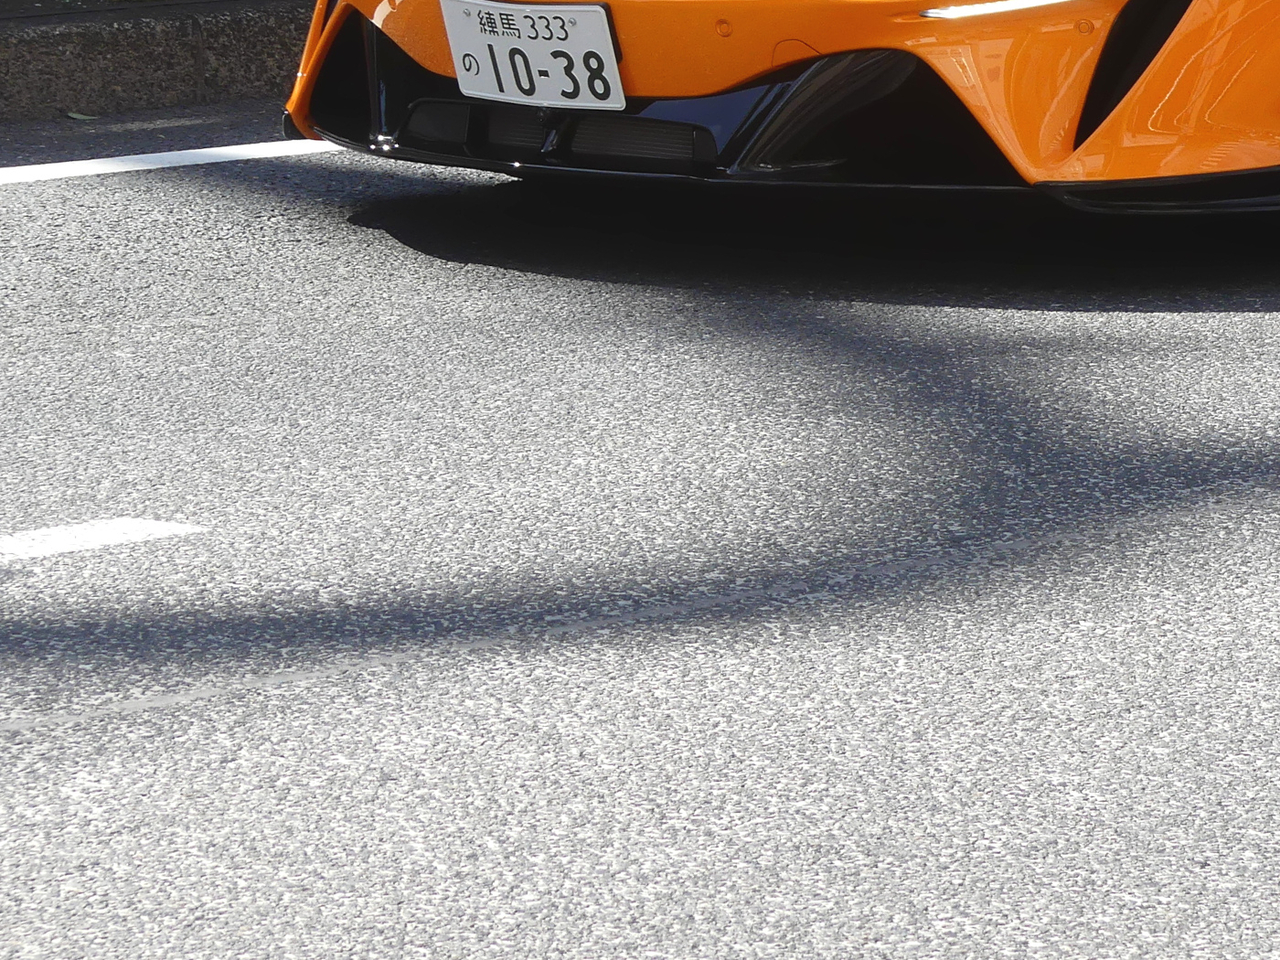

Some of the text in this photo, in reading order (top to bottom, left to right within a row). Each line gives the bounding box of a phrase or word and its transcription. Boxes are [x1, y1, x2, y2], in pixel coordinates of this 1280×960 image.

[477, 9, 569, 42] 練馬 333
[462, 43, 611, 101] の 10-38
